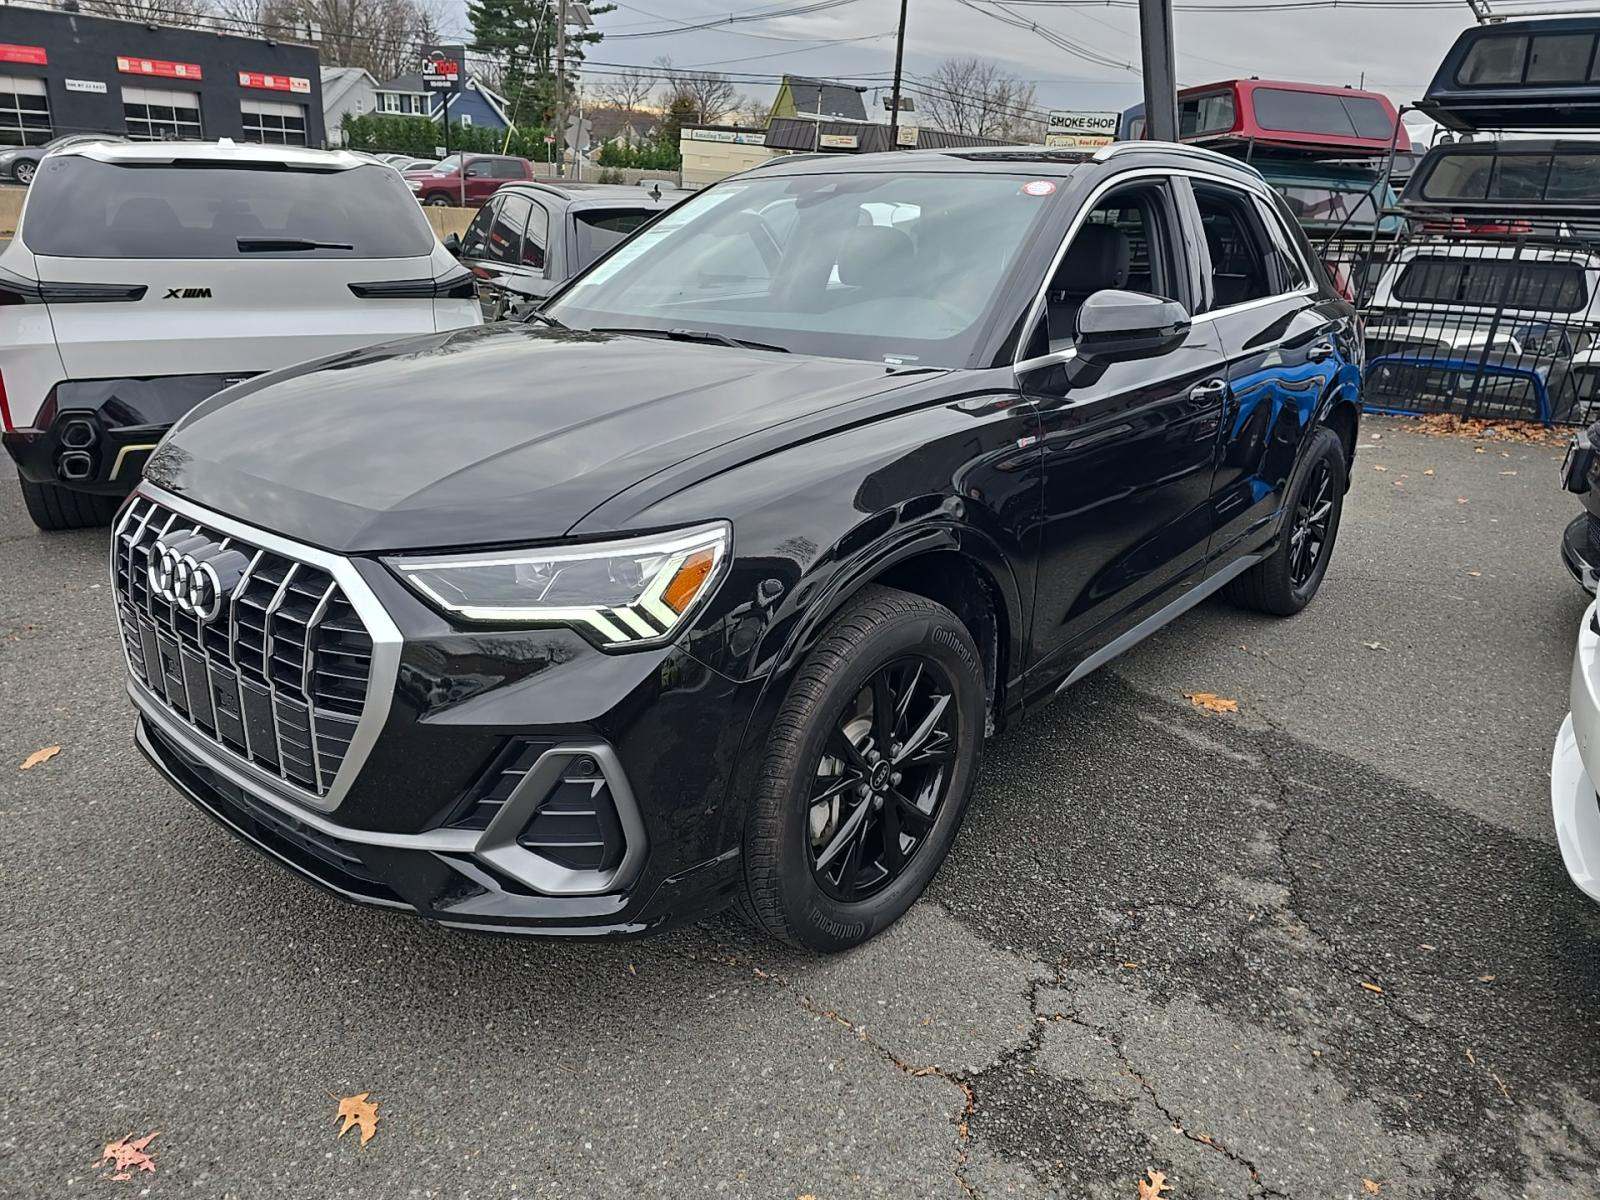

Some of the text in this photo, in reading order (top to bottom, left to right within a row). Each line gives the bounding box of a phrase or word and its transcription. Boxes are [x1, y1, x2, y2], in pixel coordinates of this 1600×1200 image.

[1050, 117, 1115, 128] SMOKE SHOP
[932, 625, 976, 673] Continental
[808, 906, 865, 940] Continental
